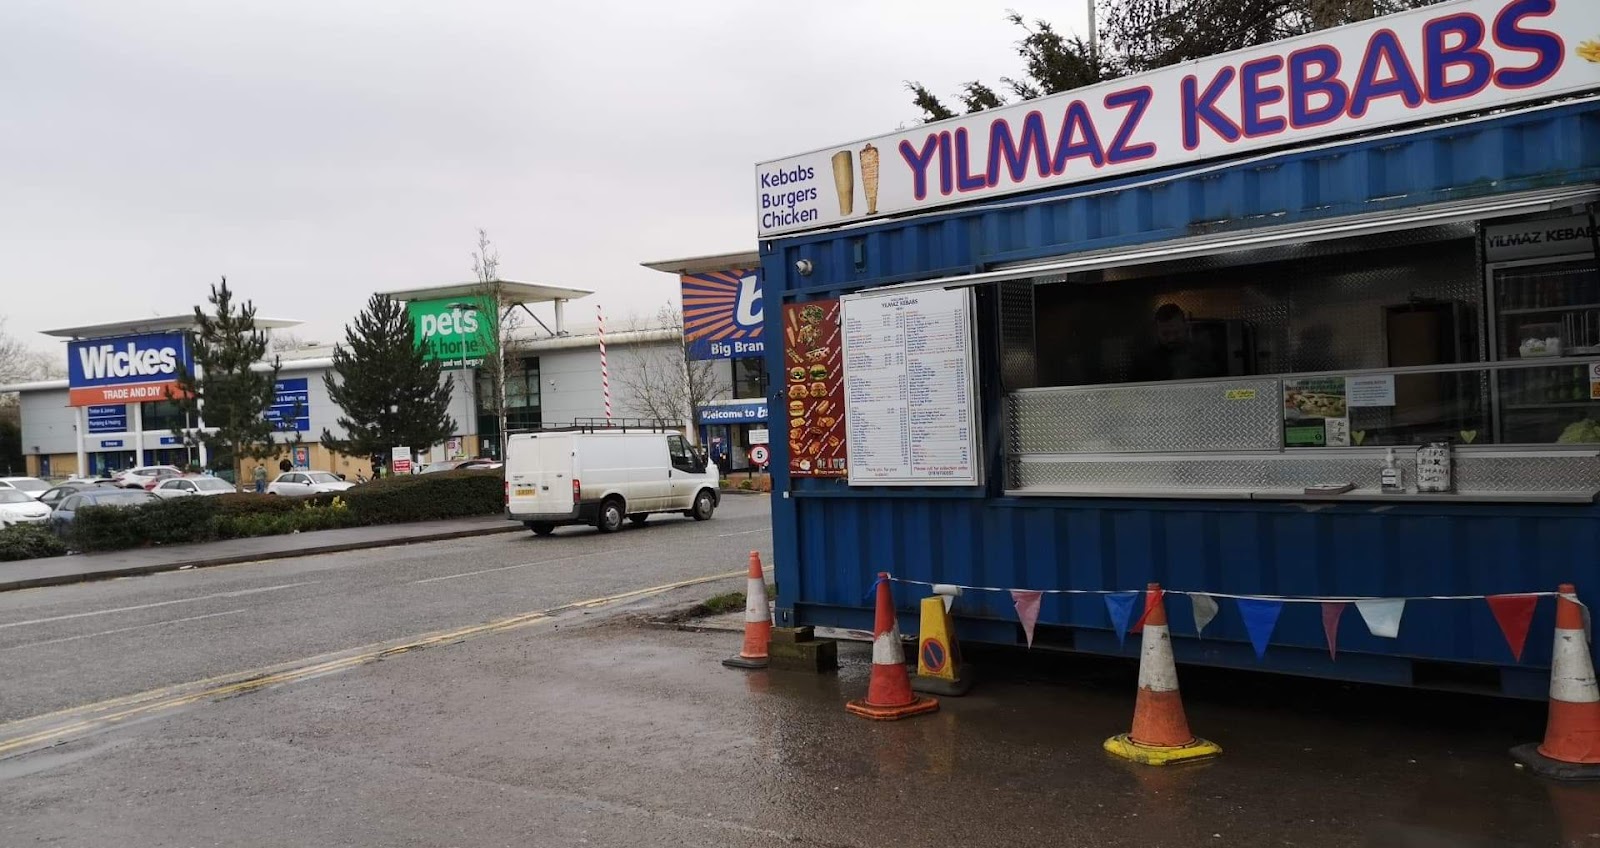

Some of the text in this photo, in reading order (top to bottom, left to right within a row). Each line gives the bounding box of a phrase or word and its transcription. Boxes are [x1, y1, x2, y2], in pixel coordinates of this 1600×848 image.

[898, 0, 1567, 201] YILMAZ KEBABS
[761, 164, 814, 188] Kebabs
[762, 186, 817, 209] Burgers
[762, 206, 818, 229] Chicken
[1487, 231, 1542, 248] YILMAZ
[421, 308, 478, 341] pets
[440, 338, 477, 354] home
[711, 342, 731, 357] Big
[79, 341, 177, 380] Wickes
[465, 358, 484, 367] urgery
[103, 386, 160, 400] TRADE AND DIY
[702, 410, 743, 419] Welcome
[745, 409, 755, 418] to
[756, 450, 763, 459] 5
